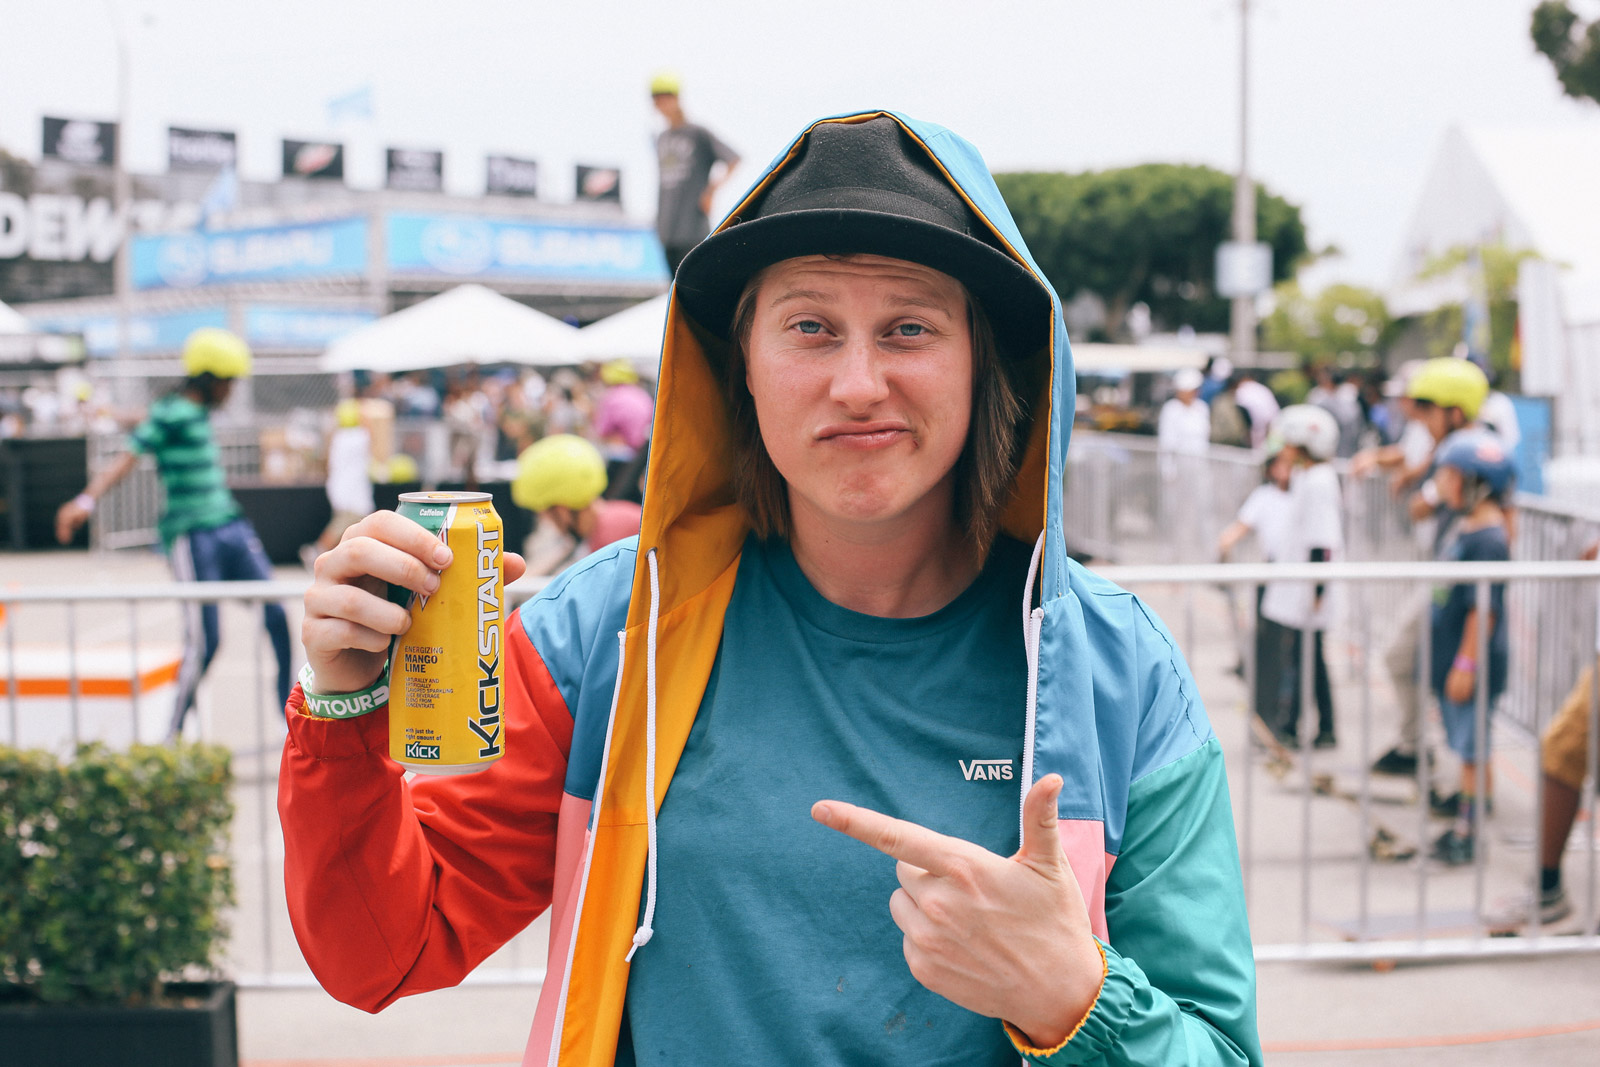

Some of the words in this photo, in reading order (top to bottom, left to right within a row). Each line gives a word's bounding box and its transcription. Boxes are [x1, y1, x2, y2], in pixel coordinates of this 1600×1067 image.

[419, 508, 444, 517] Caffeine
[467, 521, 501, 758] KICKSTART
[404, 646, 444, 655] ENERGIZING
[404, 654, 438, 664] MANGO
[404, 663, 426, 673] LIME
[406, 741, 439, 759] KICK
[958, 759, 1014, 781] VANS
